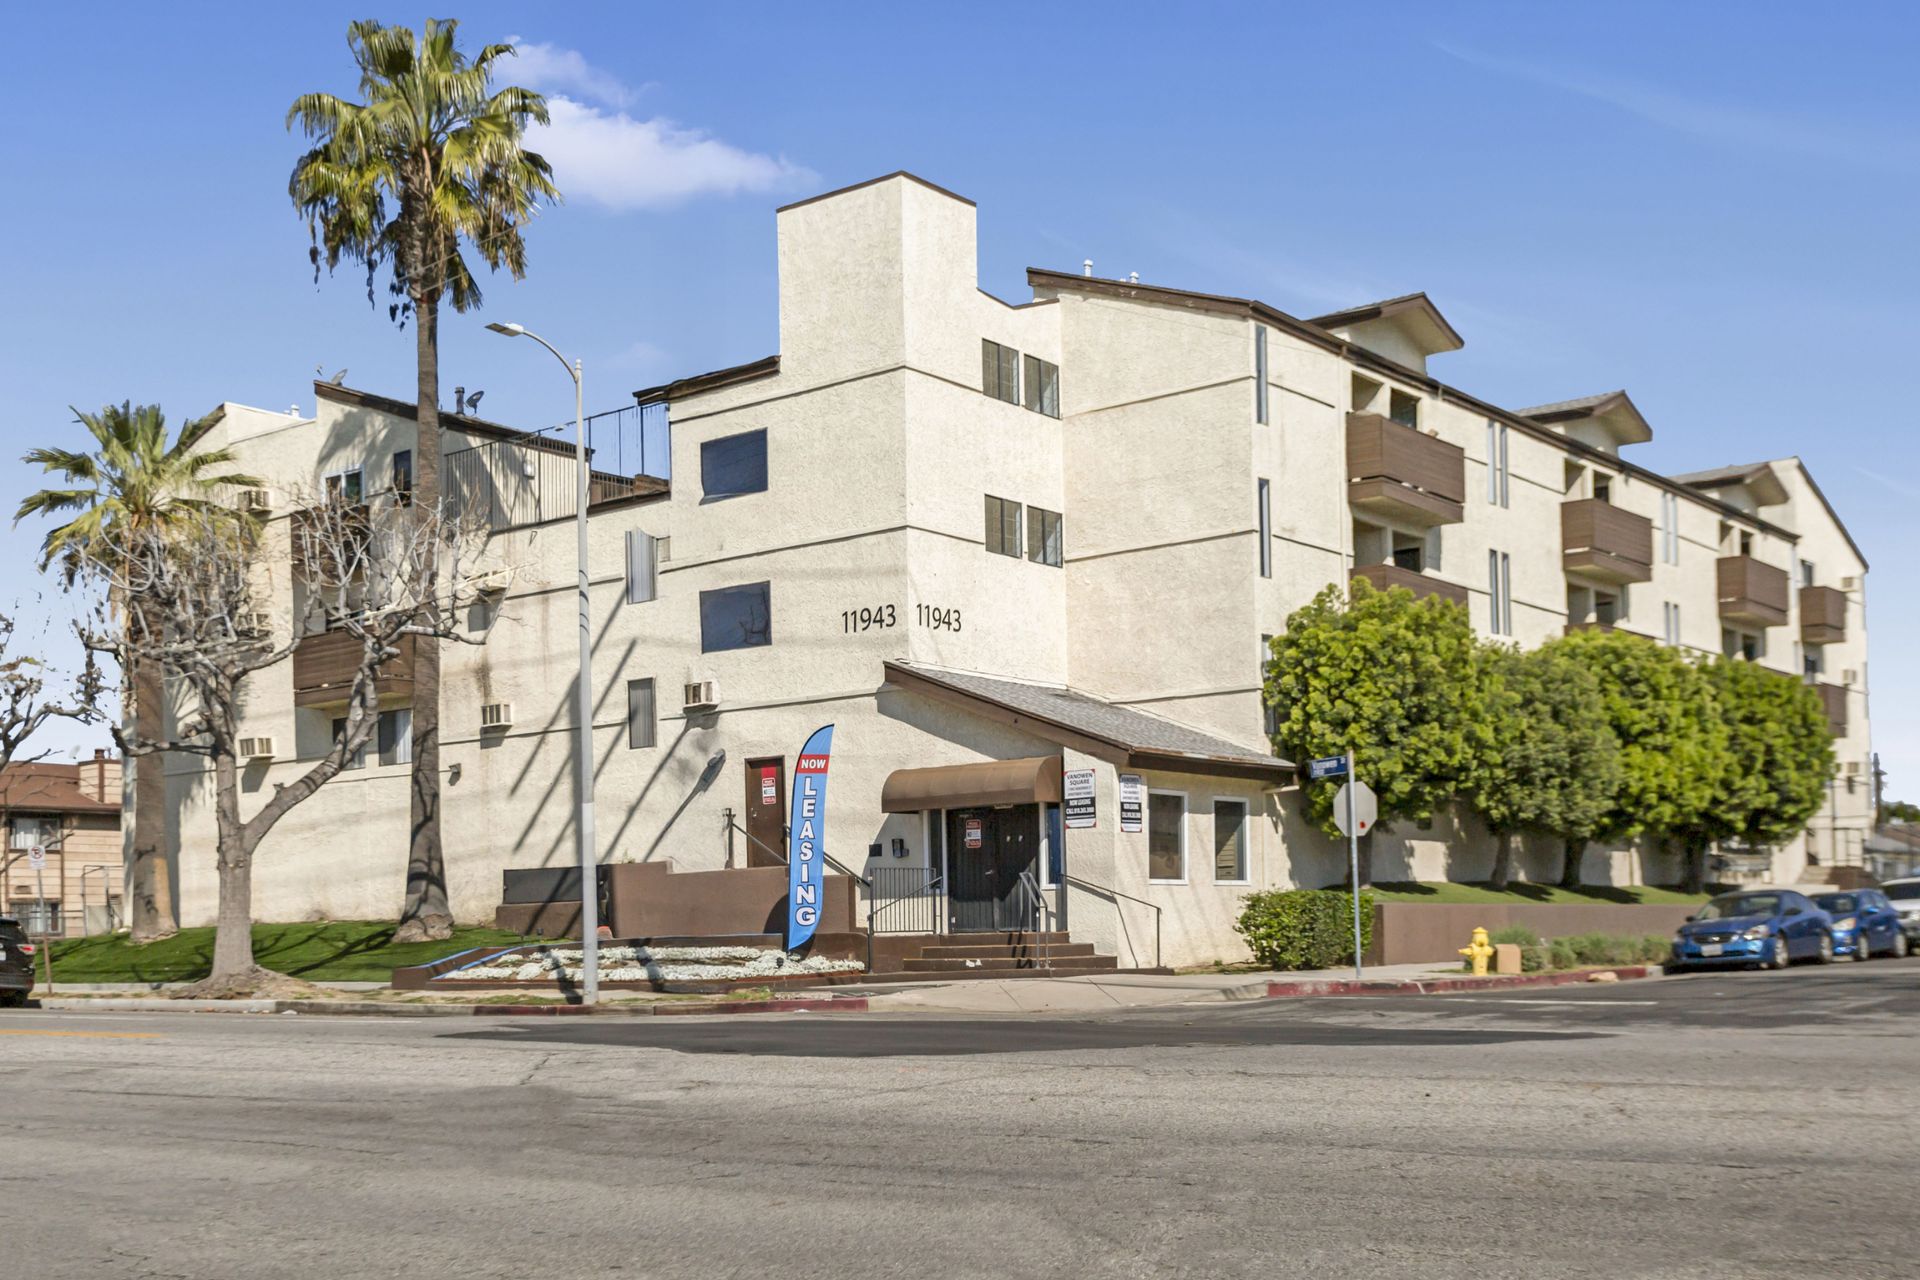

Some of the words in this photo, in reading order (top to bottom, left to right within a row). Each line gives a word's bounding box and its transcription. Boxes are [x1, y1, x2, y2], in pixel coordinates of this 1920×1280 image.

[841, 603, 896, 634] 11943
[916, 603, 962, 632] 11943
[801, 758, 827, 770] NOW
[796, 776, 816, 926] LEASING
